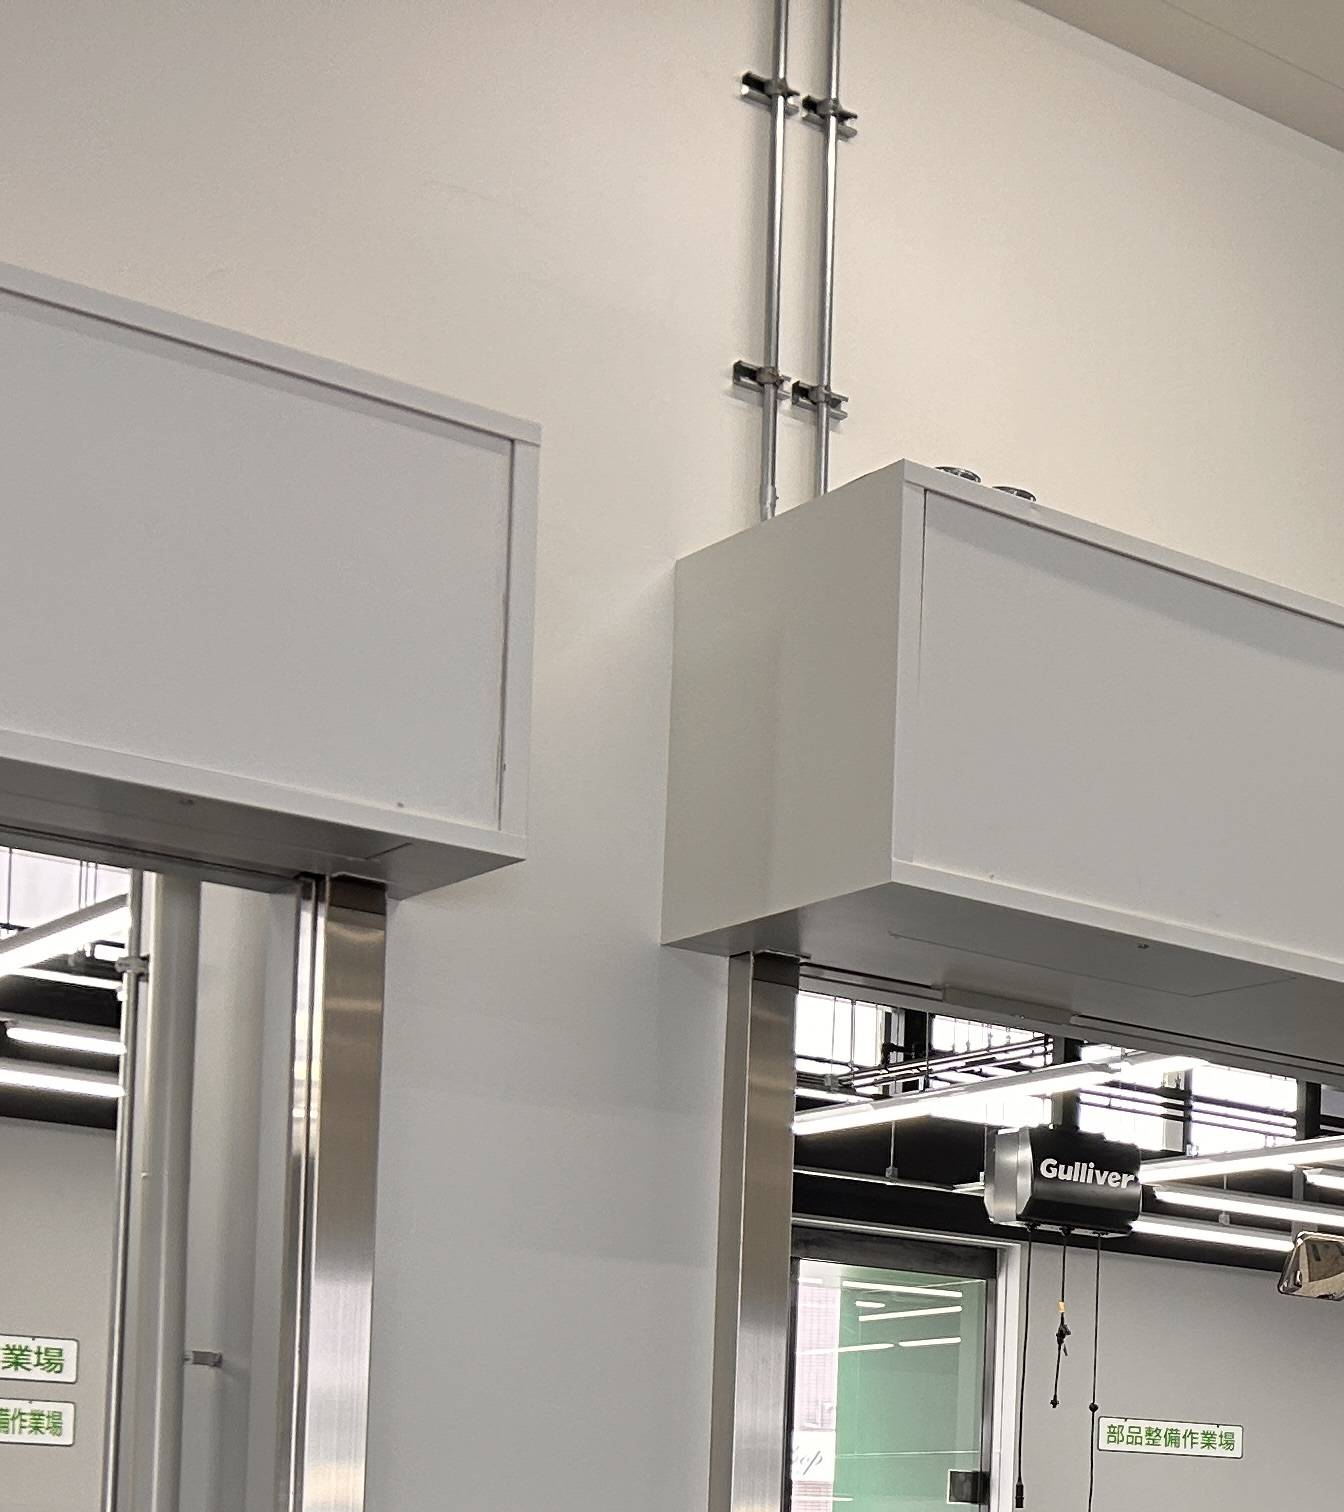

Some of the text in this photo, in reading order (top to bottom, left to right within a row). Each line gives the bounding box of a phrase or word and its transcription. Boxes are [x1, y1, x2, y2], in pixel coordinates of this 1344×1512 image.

[1040, 1158, 1135, 1189] Gulliver
[0, 1344, 64, 1374] 業場
[1106, 1424, 1236, 1451] 部品整備作業場
